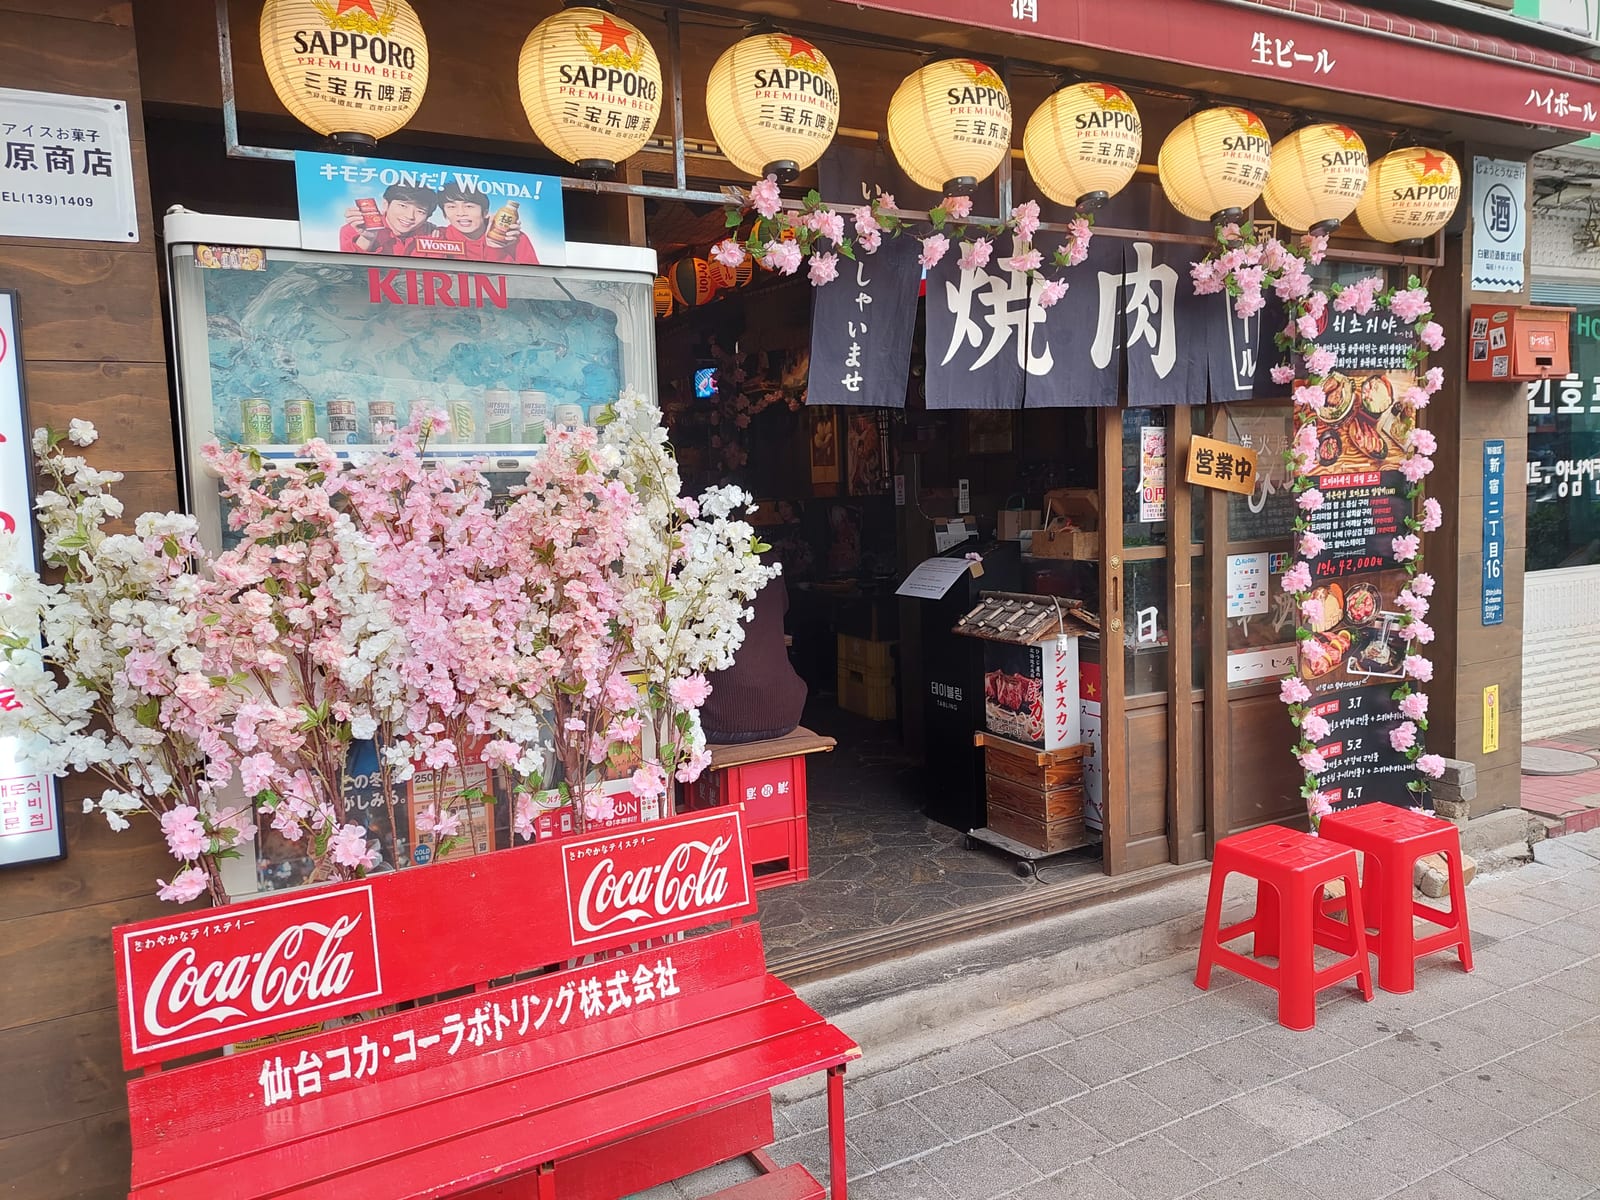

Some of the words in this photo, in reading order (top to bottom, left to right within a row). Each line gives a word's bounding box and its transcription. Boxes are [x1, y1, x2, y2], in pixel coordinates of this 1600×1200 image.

[294, 30, 415, 70] SAPPORO
[1250, 31, 1336, 74] 生ビール
[297, 57, 376, 75] PREMIUM
[382, 69, 413, 81] BEER
[559, 65, 657, 101] SAPPORO
[305, 71, 412, 102] 三宝乐啤酒
[559, 86, 627, 106] PREMIUM
[754, 68, 838, 106] SAPPORO
[755, 90, 816, 105] PREMIUM
[563, 101, 651, 132] 三宝乐啤酒
[1524, 88, 1597, 121] ハイボール
[2, 123, 100, 143] アイスお菓子
[1222, 136, 1271, 157] SAPPO
[5, 141, 113, 177] 原商店
[453, 172, 543, 200] WONDA!
[1490, 193, 1511, 233] 酒
[420, 238, 461, 252] WONDA
[368, 267, 508, 309] KIRIN
[940, 236, 1179, 379] 焼肉
[1196, 447, 1253, 484] 営業中
[1488, 457, 1500, 558] 新宿二丁目
[1486, 559, 1500, 579] 16
[1137, 606, 1158, 643] 日
[931, 681, 963, 701] 테이블링
[1347, 696, 1362, 709] 3.7
[1346, 738, 1362, 751] 5.2
[1347, 787, 1363, 799] 6.7
[578, 833, 733, 932] Coca-Cola
[144, 911, 363, 1036] Coca-Cola
[258, 957, 681, 1107] 仙台コカ・コーラボトリング株式会社
